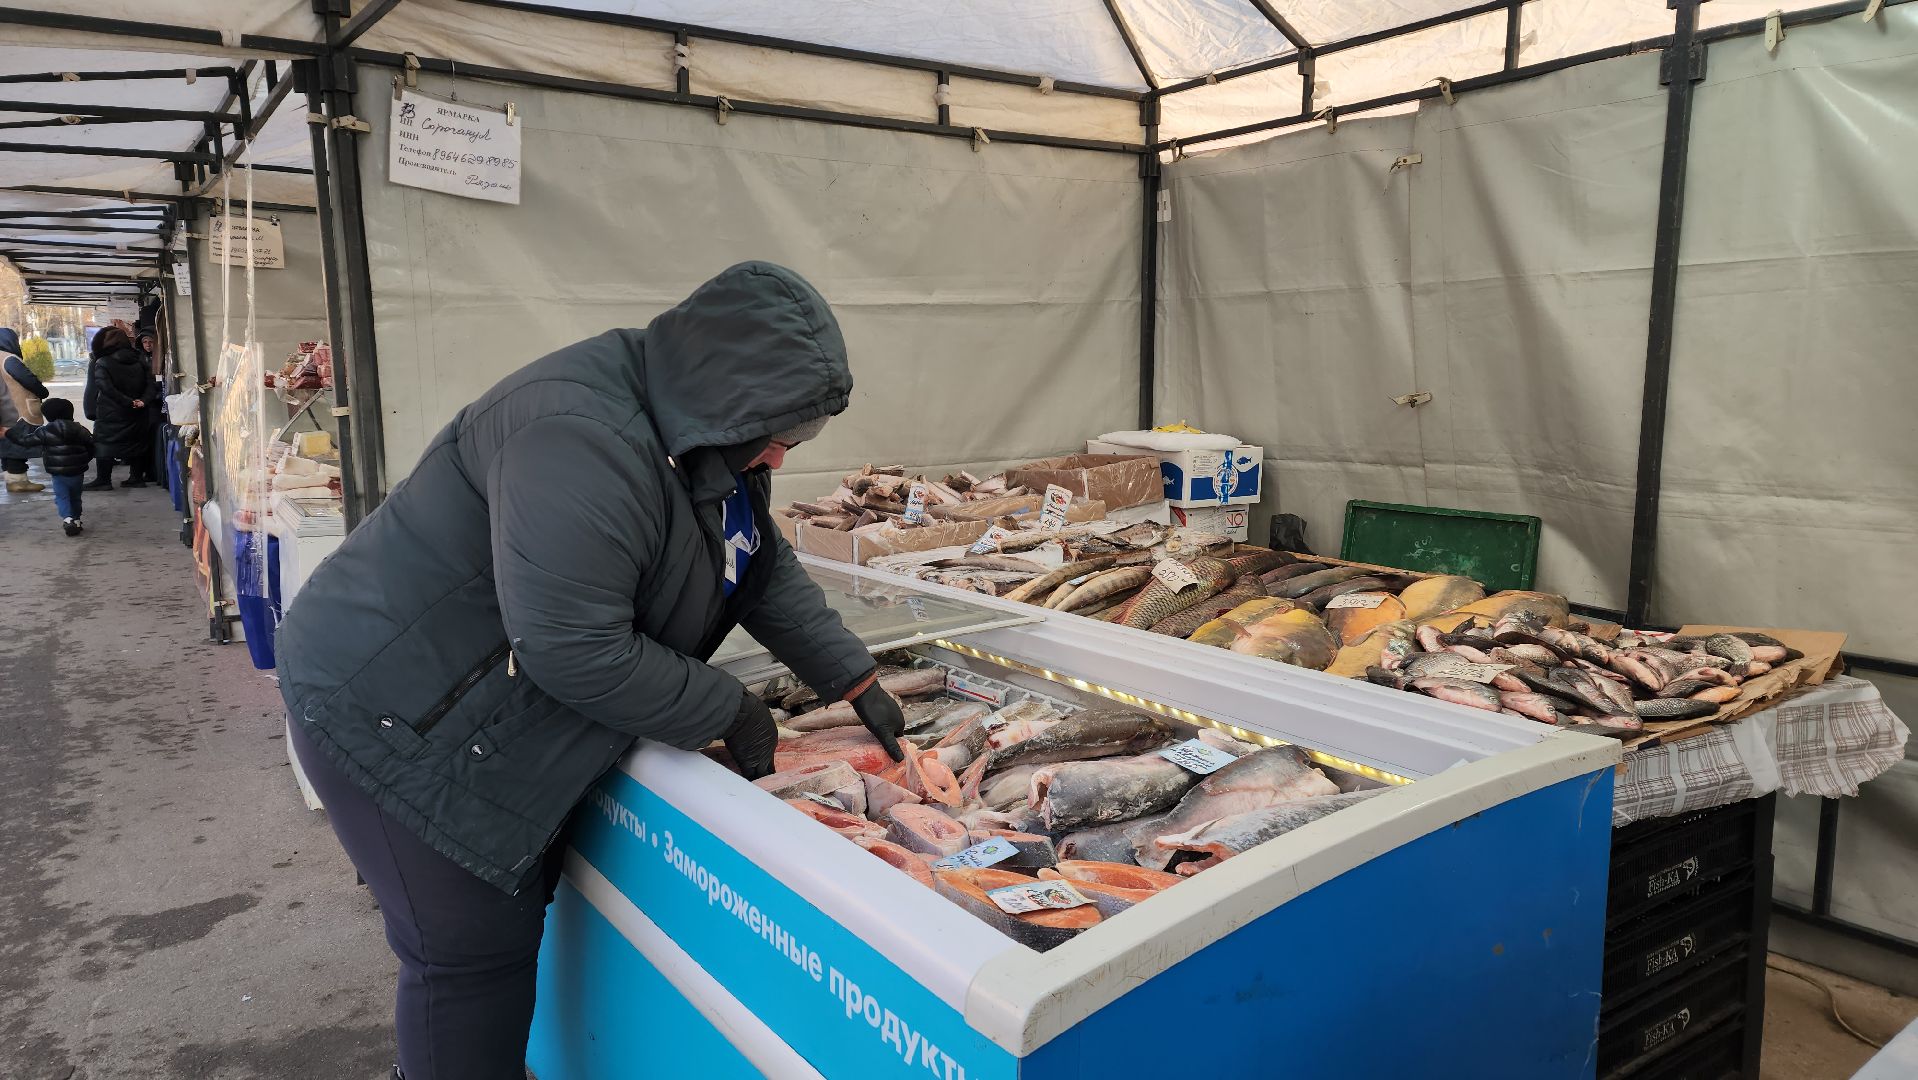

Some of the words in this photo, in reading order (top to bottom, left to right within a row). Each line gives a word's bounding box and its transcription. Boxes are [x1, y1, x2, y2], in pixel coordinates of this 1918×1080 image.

[436, 107, 480, 123] ЯРМАРКА
[399, 130, 419, 141] ИНН
[587, 786, 646, 843] родукты
[663, 830, 823, 982] Замороженные
[1648, 869, 1680, 893] Fish-KA
[1647, 947, 1678, 971] Fish-KA
